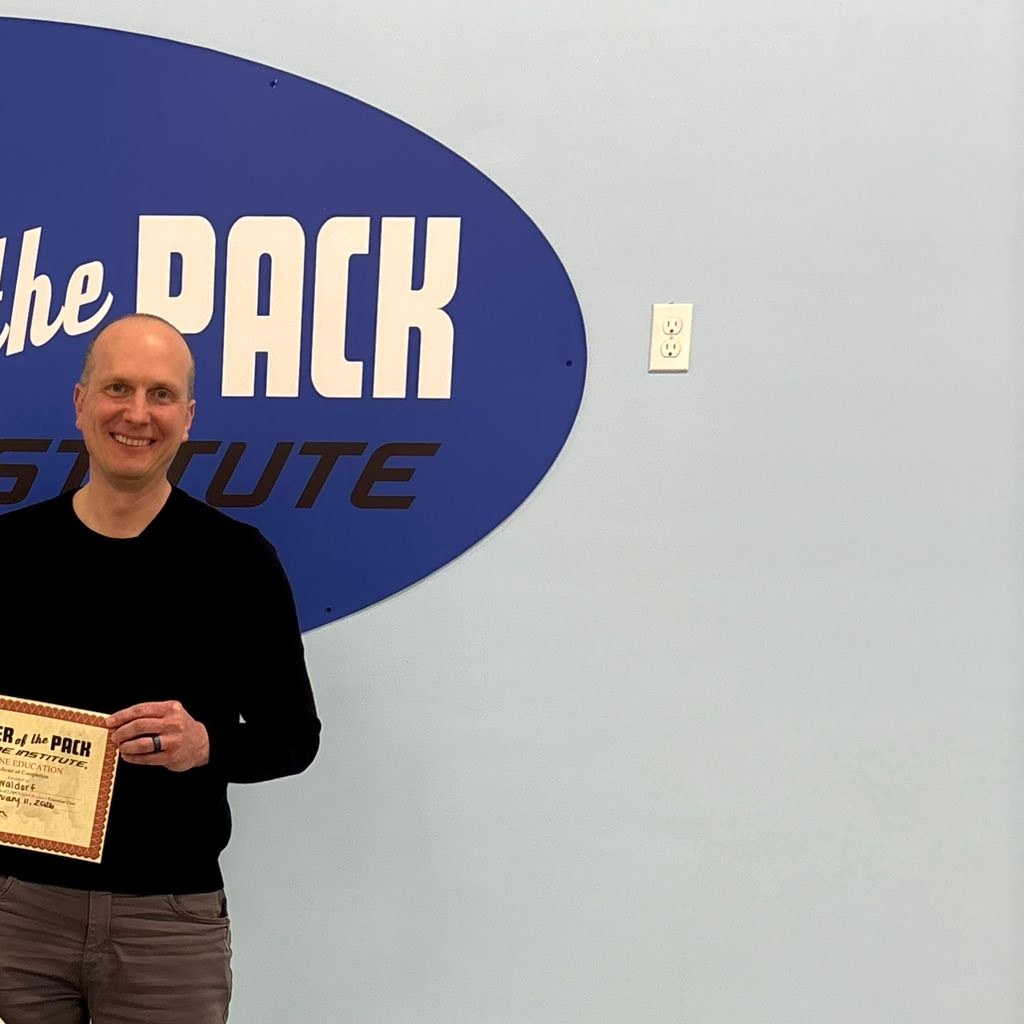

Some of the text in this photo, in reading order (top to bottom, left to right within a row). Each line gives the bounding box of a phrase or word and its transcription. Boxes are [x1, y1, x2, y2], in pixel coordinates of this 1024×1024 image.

[136, 214, 462, 400] PACK
[14, 733, 28, 747] of
[31, 733, 49, 745] the
[50, 734, 92, 758] PACK
[12, 759, 63, 774] EDUCATION
[33, 799, 54, 810] 2026
